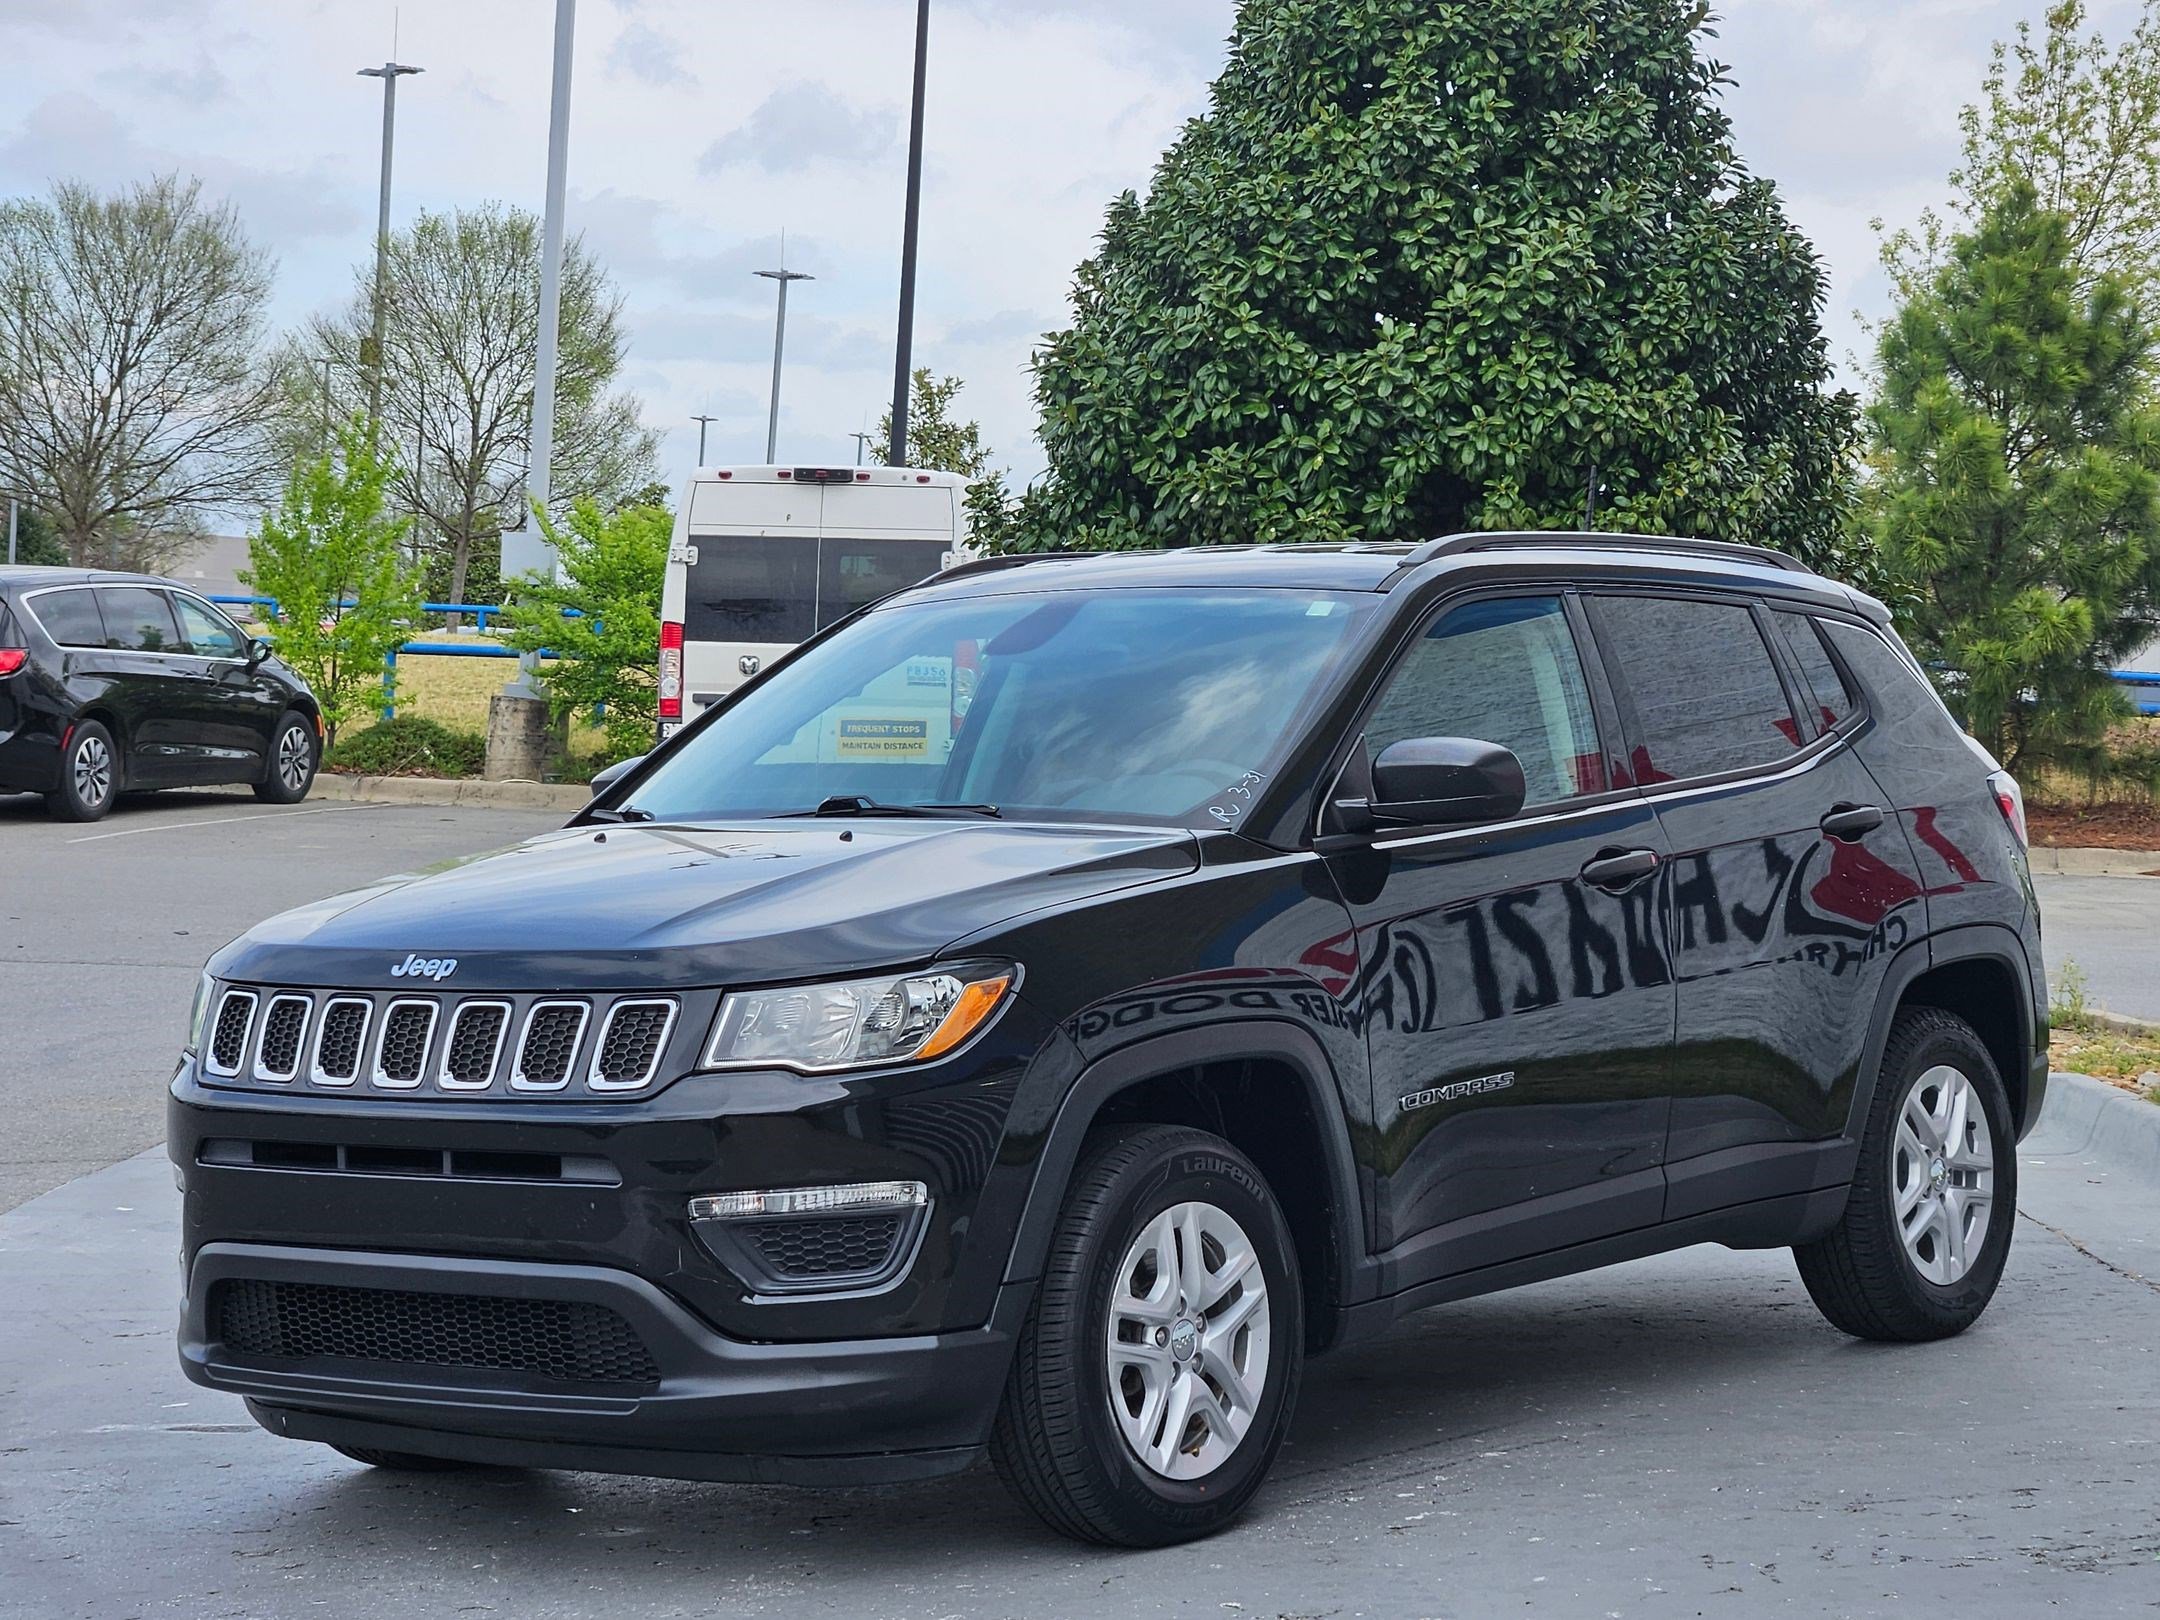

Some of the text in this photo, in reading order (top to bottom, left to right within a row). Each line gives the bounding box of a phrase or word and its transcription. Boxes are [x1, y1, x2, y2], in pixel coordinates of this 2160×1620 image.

[847, 724, 920, 734] FREQUENT STOPS
[841, 741, 924, 750] MAINTAIN DISTANCE
[390, 953, 458, 982] Jeep
[1398, 1071, 1515, 1112] COMPASS
